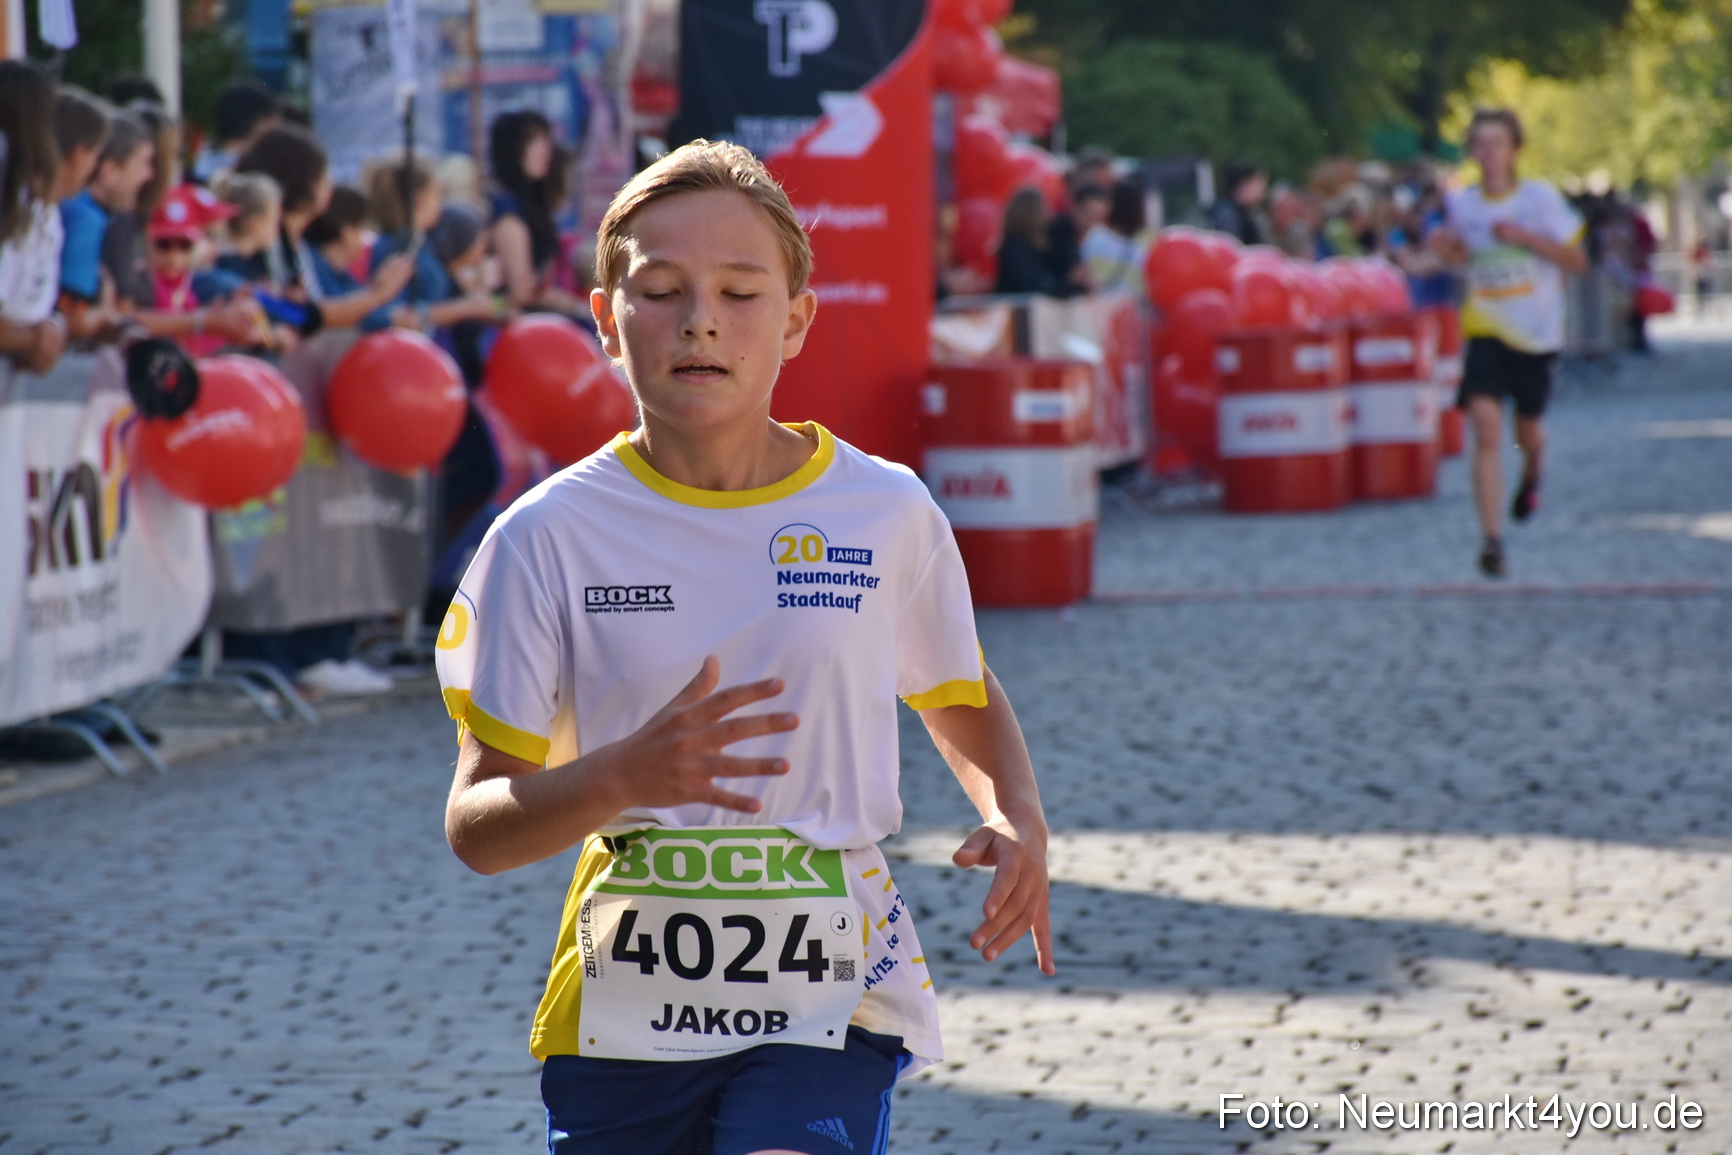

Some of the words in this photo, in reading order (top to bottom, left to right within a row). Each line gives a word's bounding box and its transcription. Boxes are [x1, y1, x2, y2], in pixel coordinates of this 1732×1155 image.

[777, 534, 824, 564] 20
[831, 549, 869, 563] JAHRE
[777, 570, 880, 589] Neumarkter
[585, 585, 674, 605] BOCK
[777, 591, 862, 613] Stadtlauf
[613, 606, 622, 614] by
[644, 605, 675, 613] concepts
[610, 839, 827, 889] BOCK
[837, 917, 847, 930] J
[611, 909, 830, 983] 4024
[650, 1003, 789, 1036] JAKOB
[807, 1122, 854, 1151] adidas
